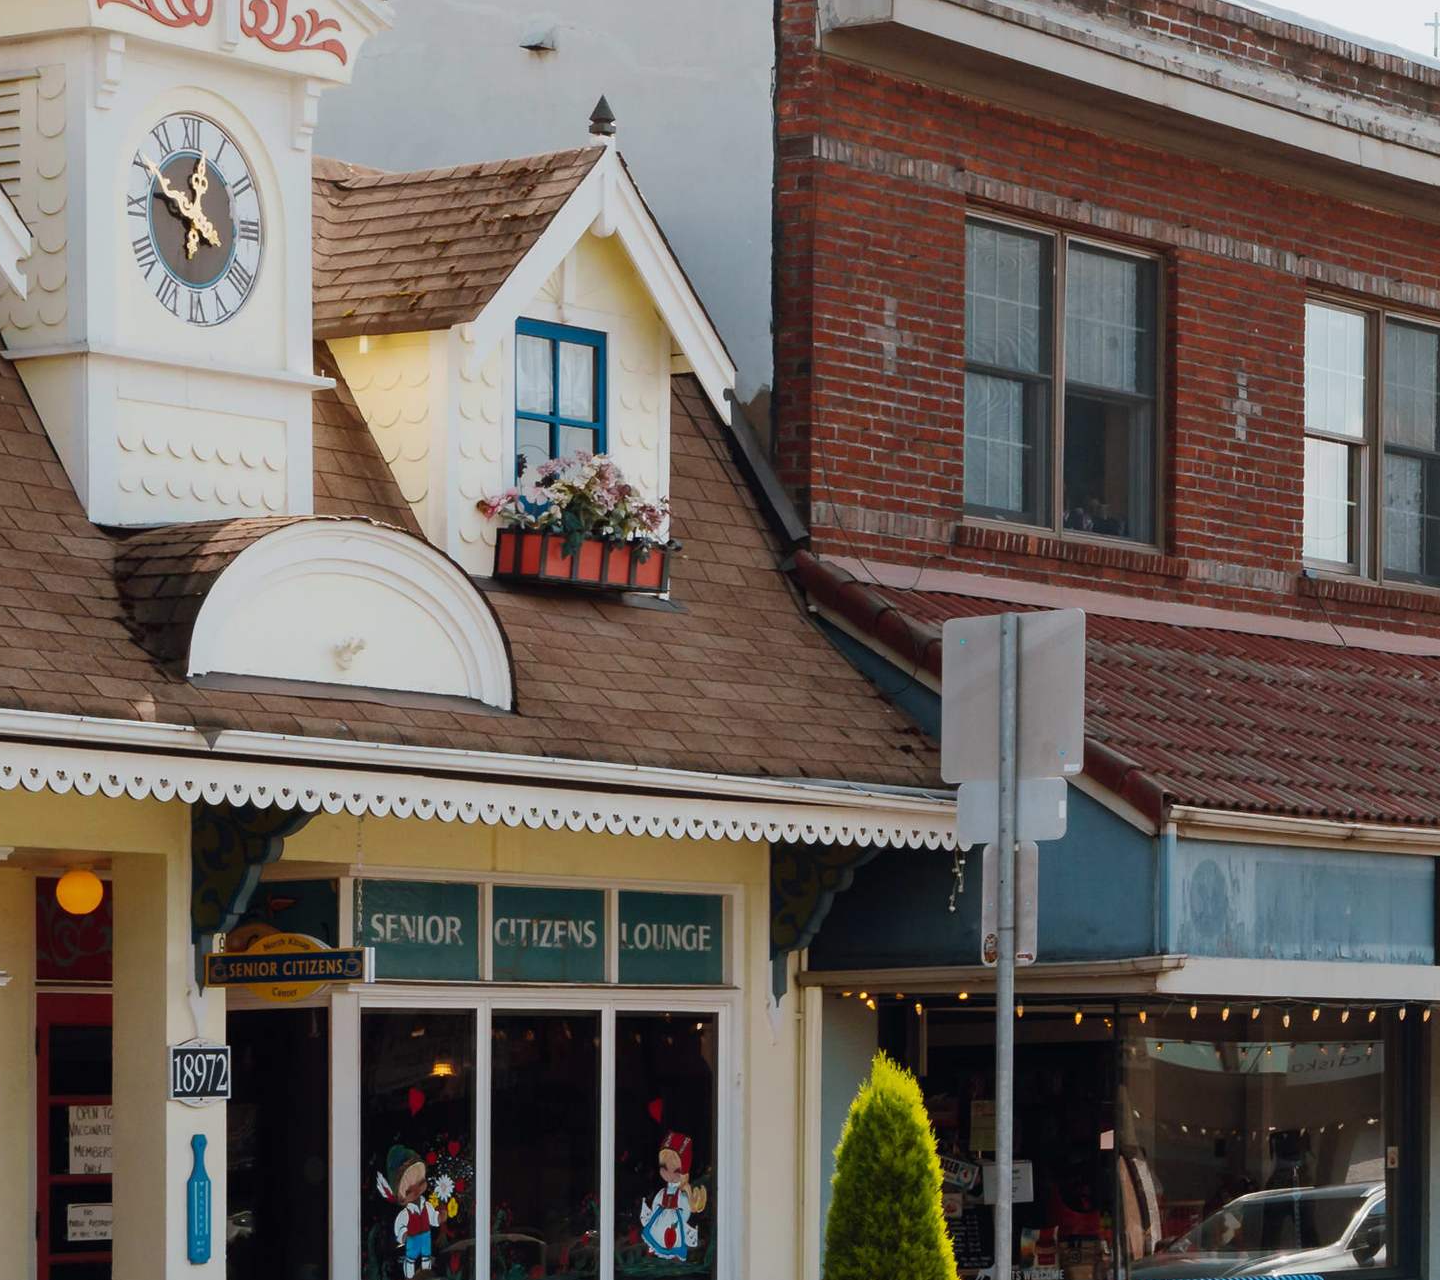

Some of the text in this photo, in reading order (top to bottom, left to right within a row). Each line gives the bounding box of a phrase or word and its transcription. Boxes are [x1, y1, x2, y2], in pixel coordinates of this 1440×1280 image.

[371, 913, 711, 951] SENIOR CITIZENS LOUNGE
[229, 959, 342, 977] SENIOR CITIZENS
[174, 1054, 228, 1093] 18972
[69, 1122, 112, 1137] VACCINATE
[1023, 1269, 1065, 1280] WELCOME
